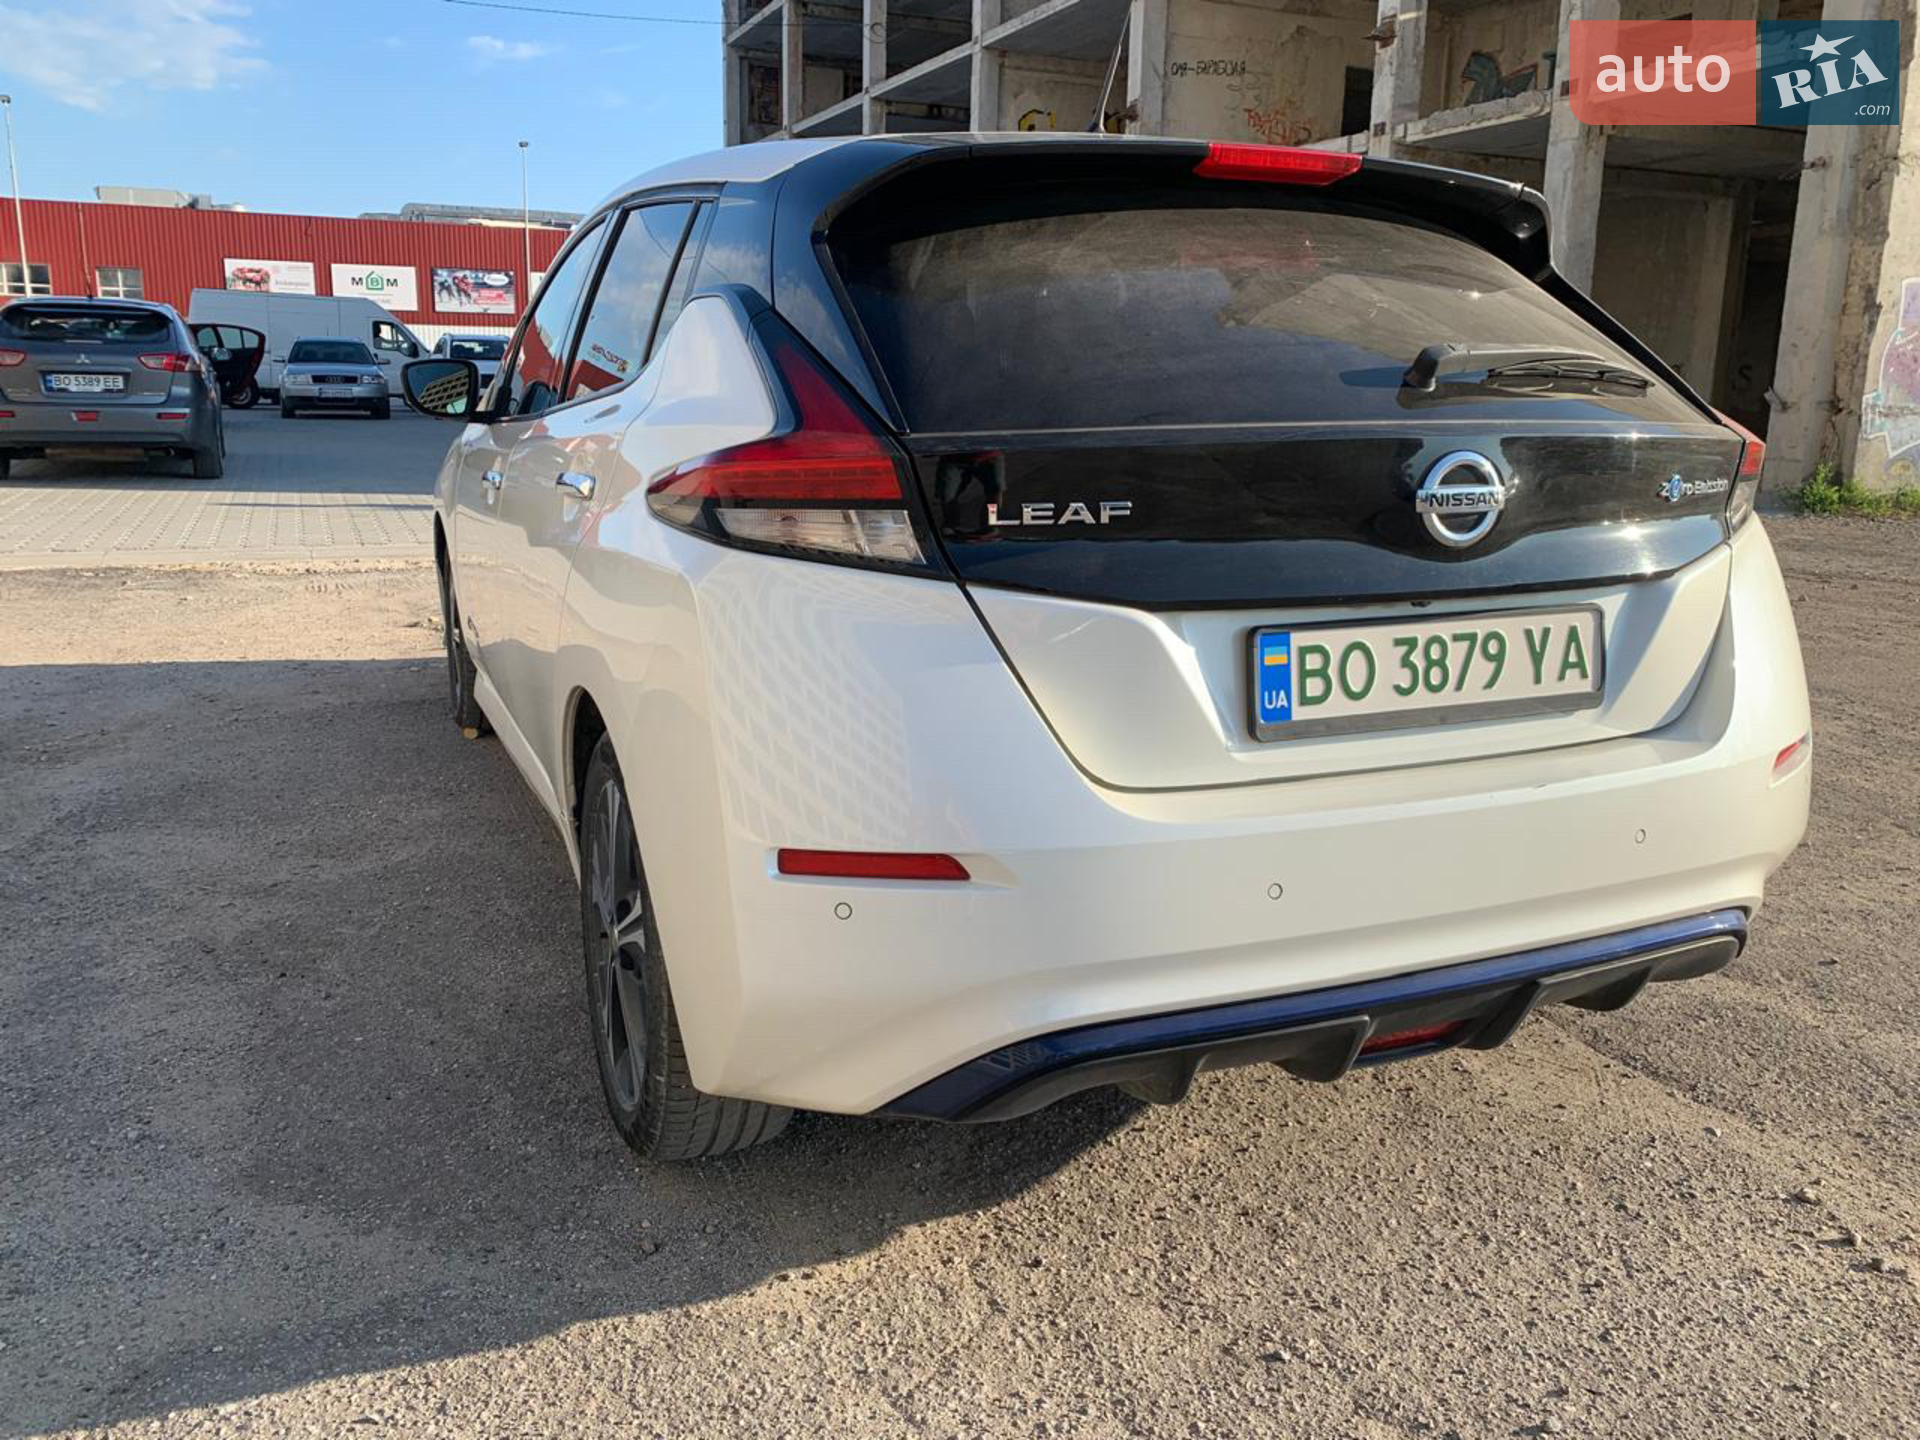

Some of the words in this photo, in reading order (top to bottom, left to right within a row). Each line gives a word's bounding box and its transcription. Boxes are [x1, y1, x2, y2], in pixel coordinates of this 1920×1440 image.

[53, 376, 71, 387] BO
[74, 376, 101, 387] 5389
[103, 377, 121, 388] EE
[1428, 491, 1500, 508] NISSAN
[986, 501, 1133, 526] LEAF
[1298, 640, 1377, 707] BO
[1392, 630, 1508, 698] 3879
[1524, 624, 1590, 685] YA
[1264, 689, 1289, 710] UA
